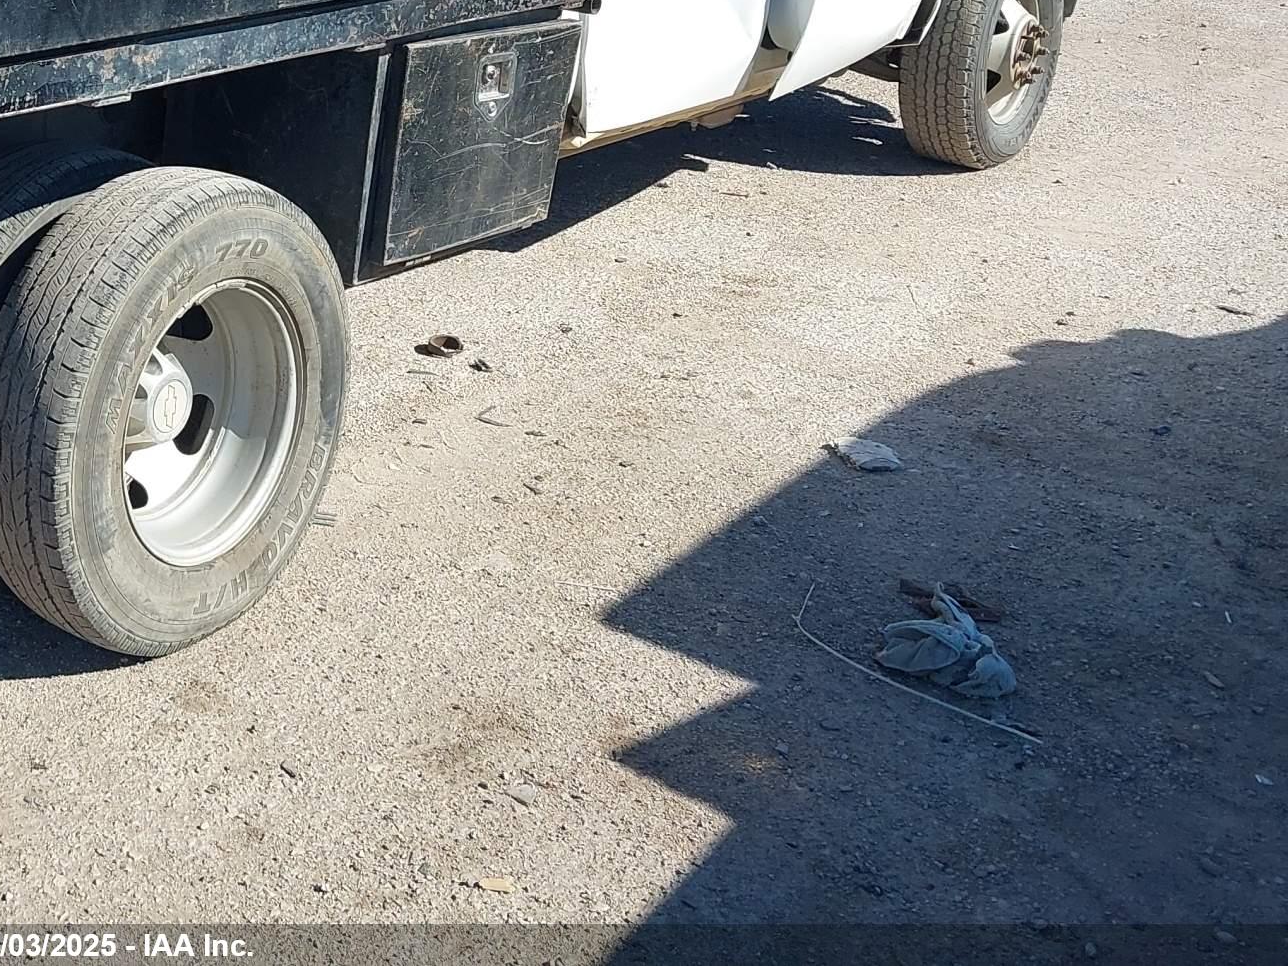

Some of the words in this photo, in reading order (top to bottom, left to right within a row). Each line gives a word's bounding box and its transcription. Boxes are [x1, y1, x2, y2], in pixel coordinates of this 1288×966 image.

[215, 238, 269, 263] 770
[105, 263, 196, 435] MAXXIS
[261, 442, 326, 572] BRAVO
[192, 569, 250, 616] H/T
